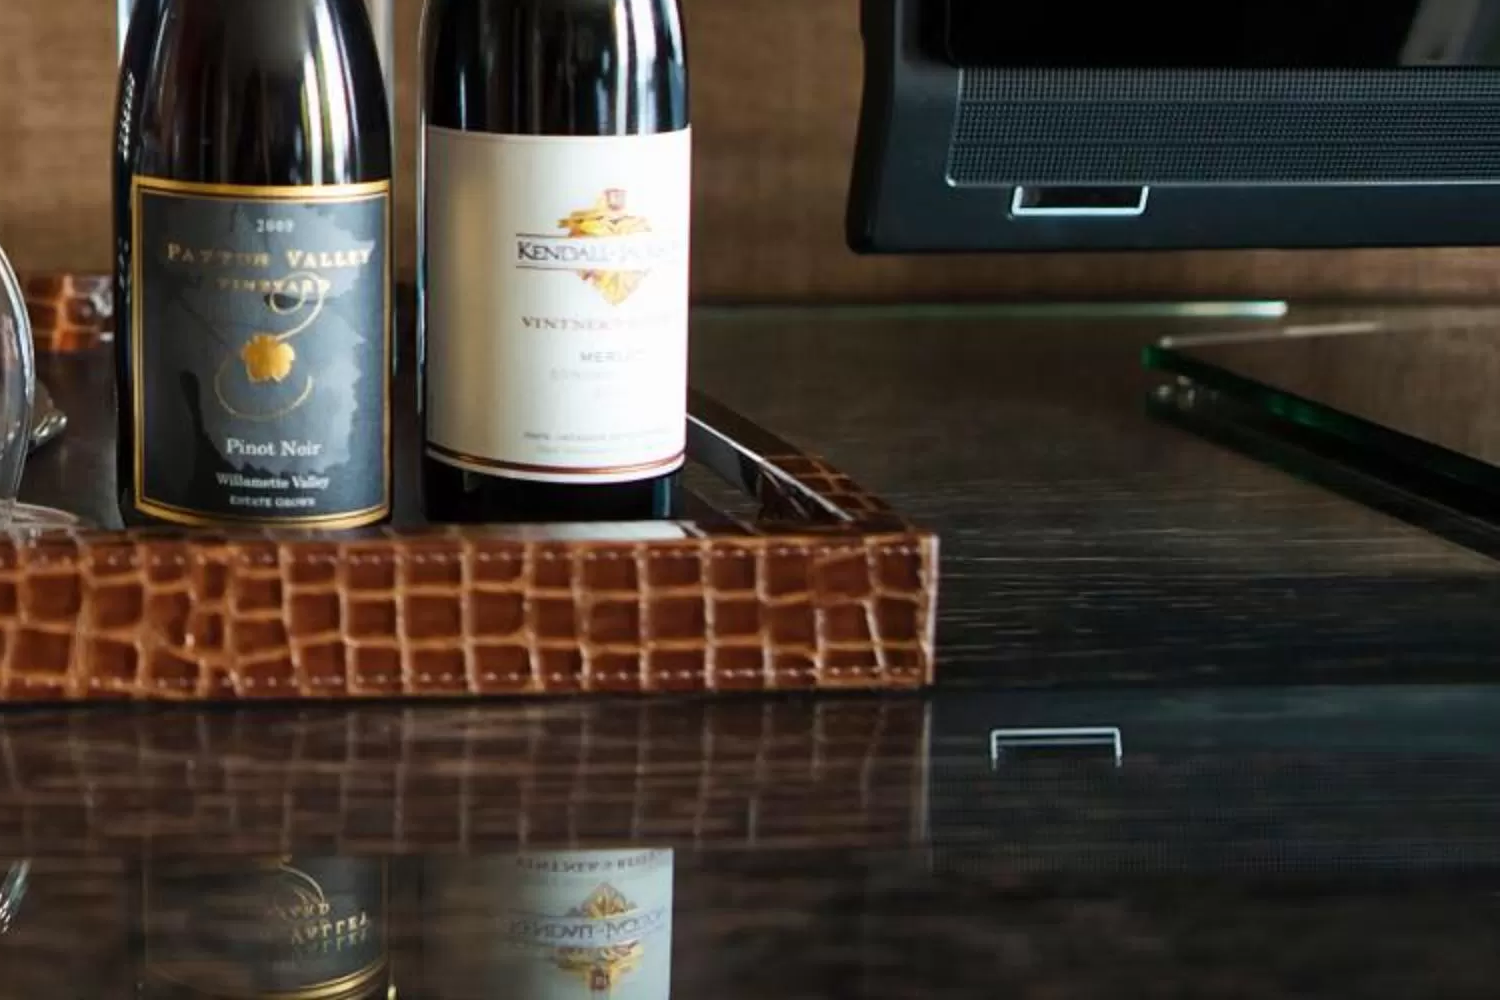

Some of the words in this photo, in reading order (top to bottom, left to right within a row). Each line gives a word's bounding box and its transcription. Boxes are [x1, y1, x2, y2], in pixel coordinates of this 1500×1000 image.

[287, 240, 375, 269] VALLEY
[226, 437, 277, 457] Pinot
[280, 440, 323, 457] Noir
[215, 472, 290, 489] Willamette
[291, 474, 330, 491] Valley
